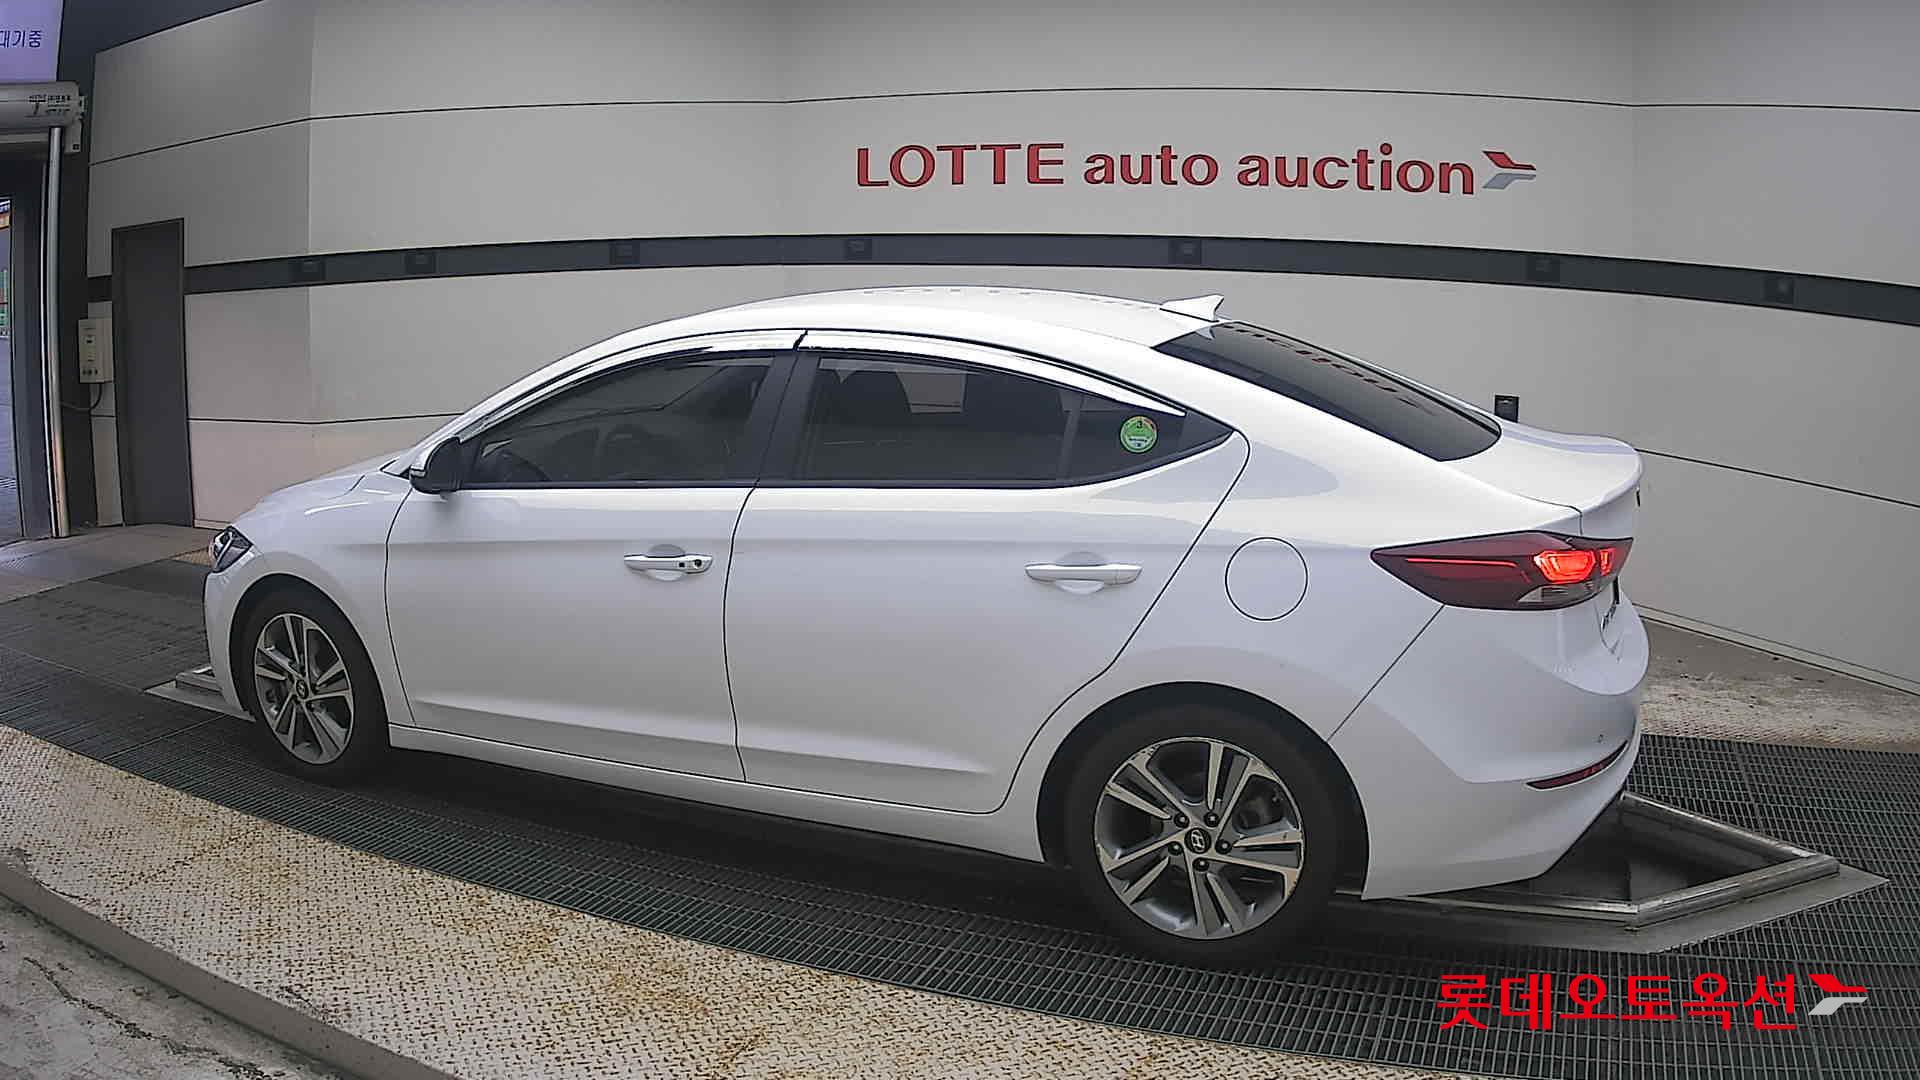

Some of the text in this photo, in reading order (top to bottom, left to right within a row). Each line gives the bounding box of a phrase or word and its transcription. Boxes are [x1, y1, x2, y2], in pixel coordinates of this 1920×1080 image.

[856, 143, 1475, 195] LOTTE auto auction
